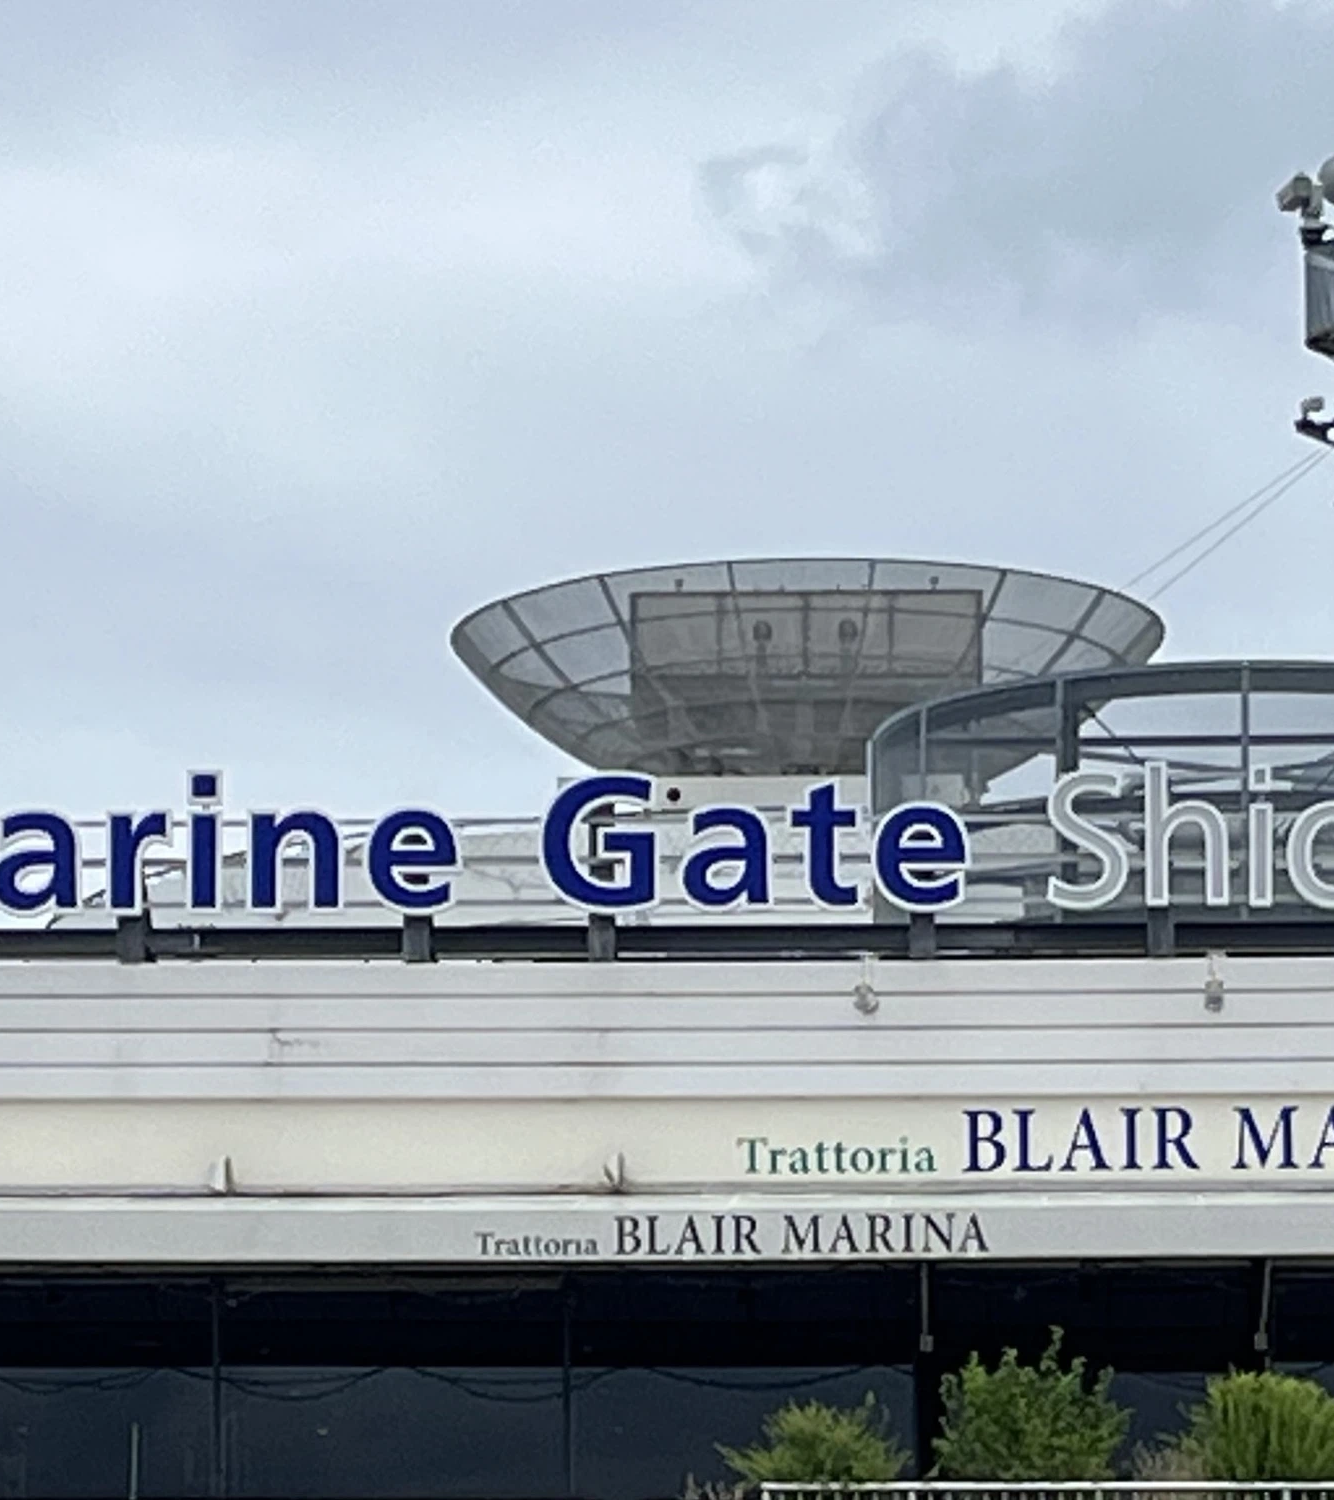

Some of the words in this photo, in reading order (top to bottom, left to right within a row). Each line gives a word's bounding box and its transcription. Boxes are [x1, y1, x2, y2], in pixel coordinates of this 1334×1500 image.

[543, 772, 972, 911] Gate
[737, 1136, 936, 1175] Trattoria
[961, 1108, 1201, 1174] BLAIR
[474, 1231, 599, 1257] Trattoria
[613, 1214, 763, 1257] BLAIR
[781, 1211, 990, 1255] MARINA
